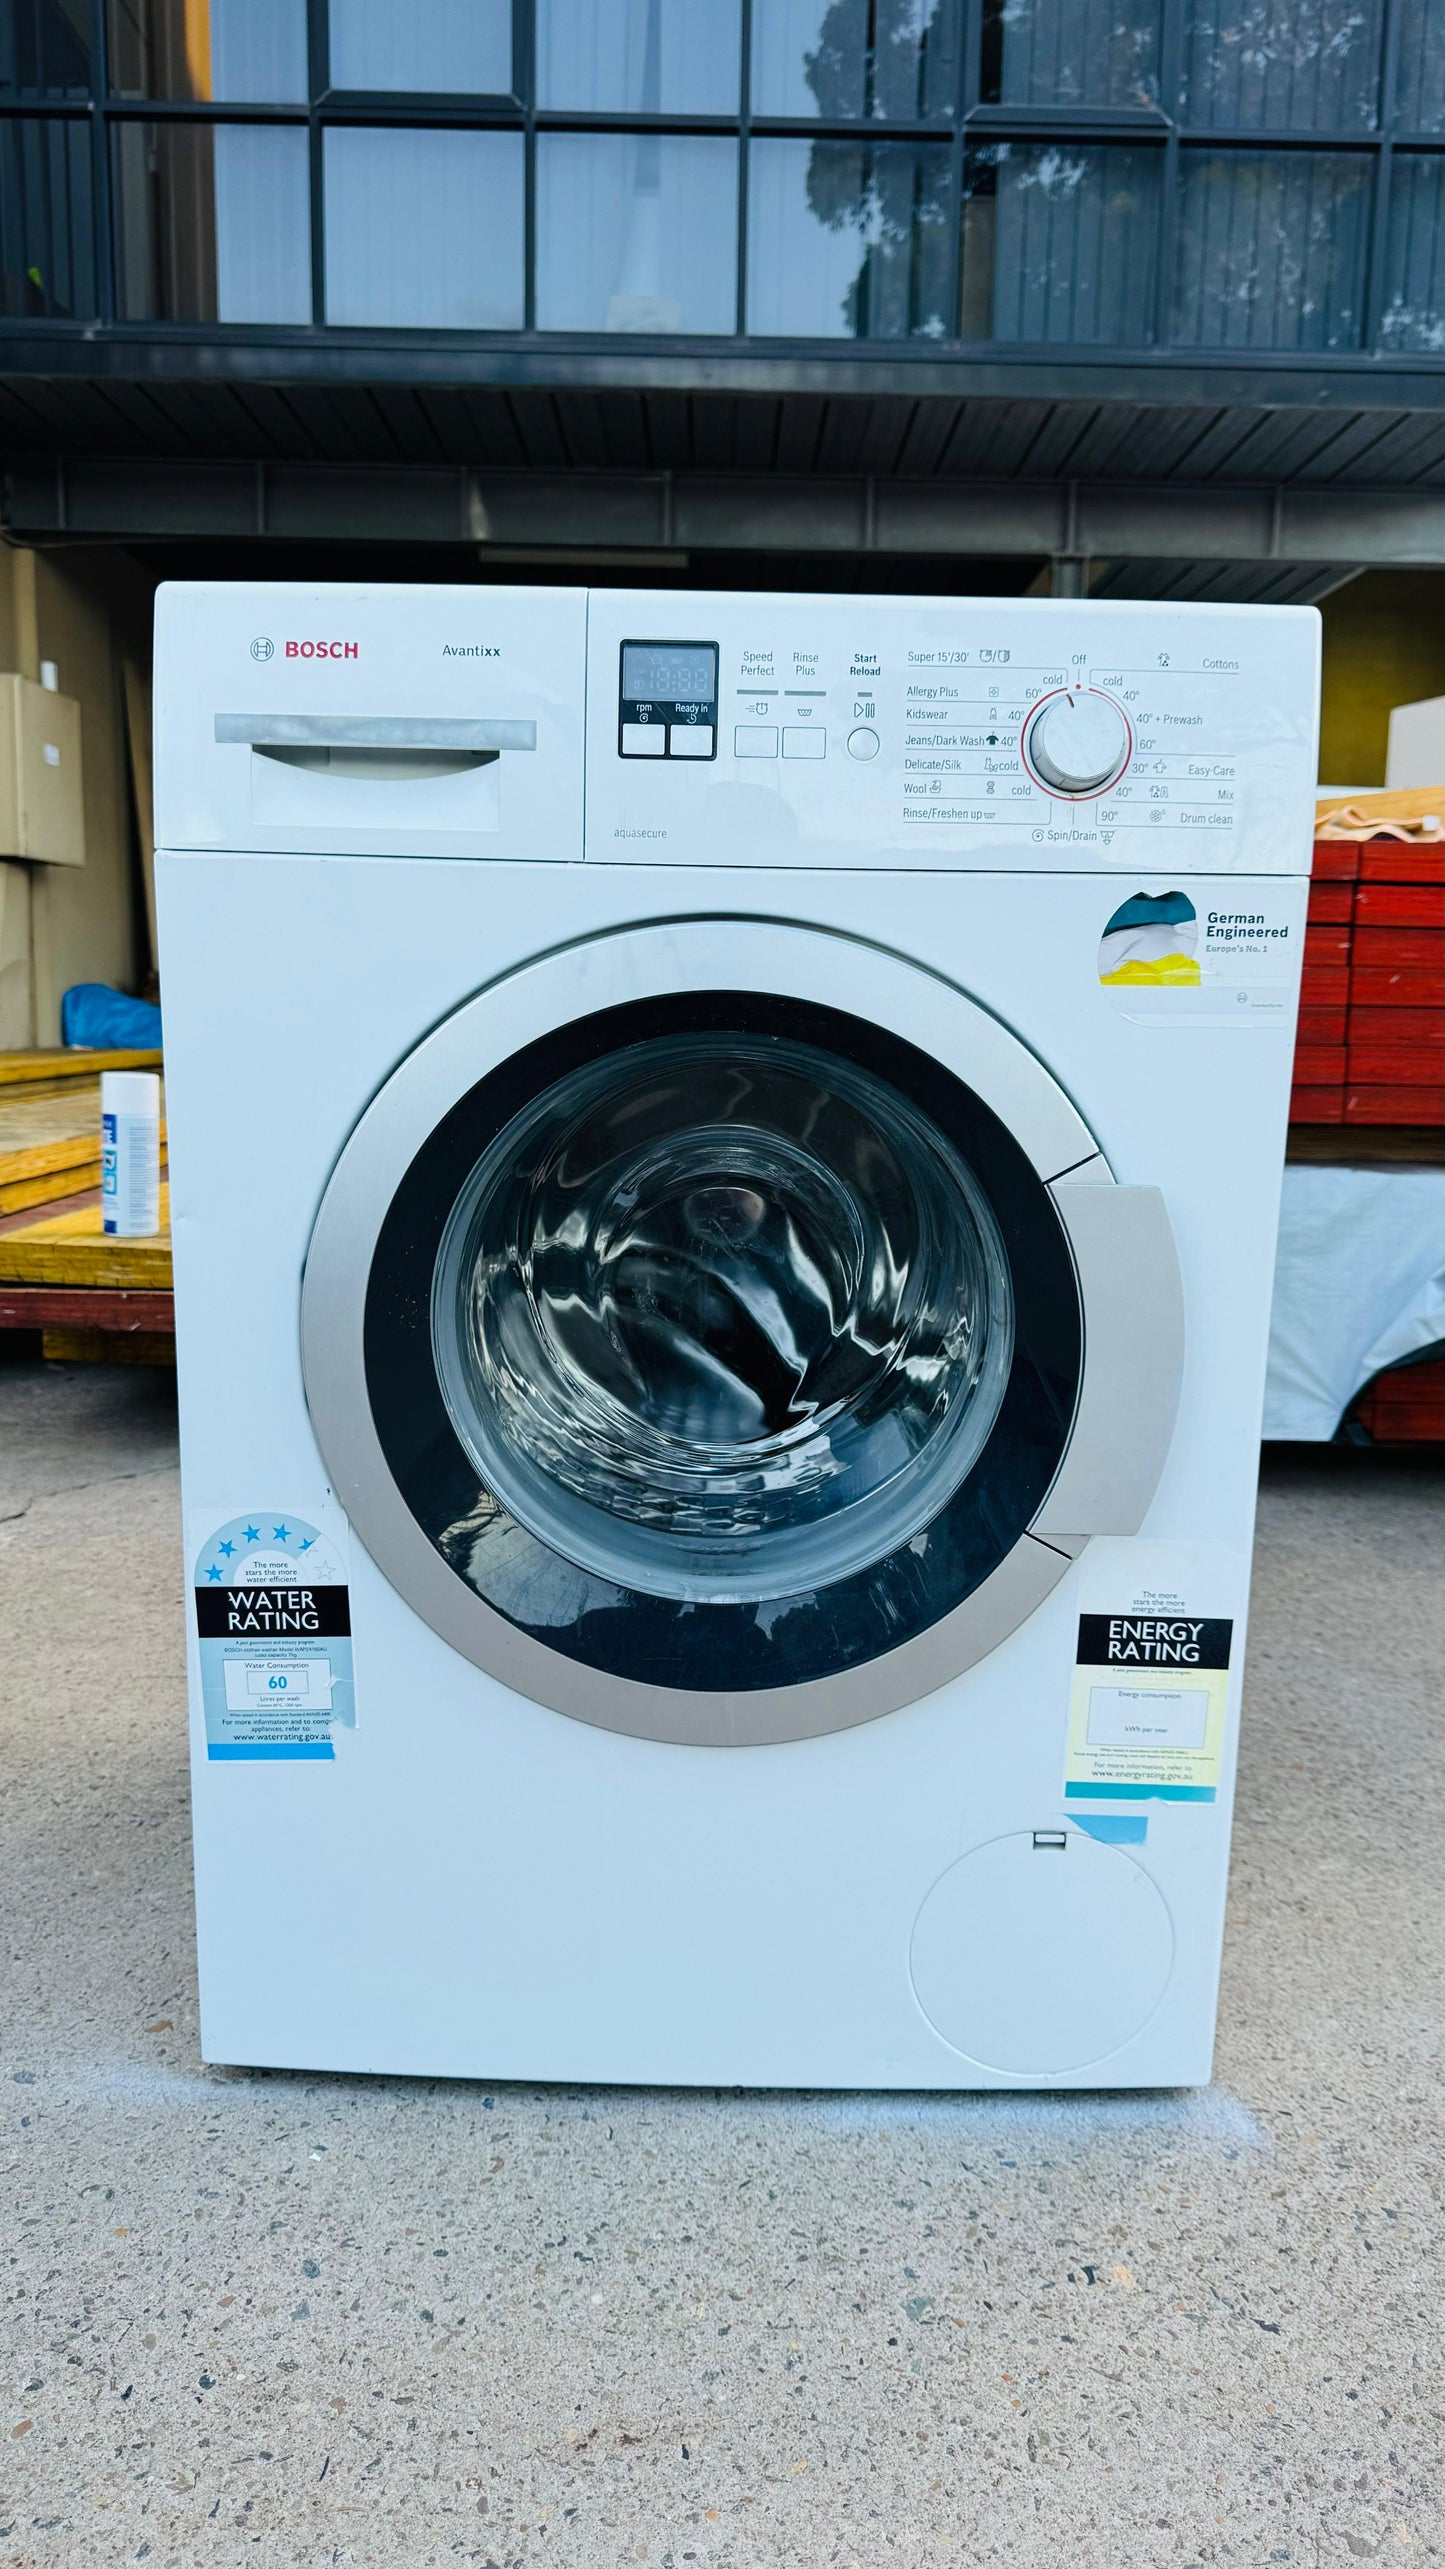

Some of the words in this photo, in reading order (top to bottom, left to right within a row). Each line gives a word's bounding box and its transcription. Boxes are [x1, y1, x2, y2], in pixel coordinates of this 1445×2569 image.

[285, 641, 358, 659] BOSCH
[443, 644, 501, 657] Avantixx
[743, 652, 773, 663] Speed
[793, 653, 818, 662] Rinse
[854, 653, 877, 663] Start
[908, 652, 936, 664] Super
[1072, 655, 1087, 665] Off
[1202, 658, 1239, 669] Cottons
[741, 666, 775, 676] Perfect
[796, 666, 815, 676] Plus
[850, 667, 880, 676] Reload
[1043, 674, 1062, 685] cold
[1103, 675, 1122, 686] cold
[907, 687, 937, 698] Allergy
[939, 687, 958, 697] Plus
[1026, 688, 1042, 698] 60°
[1123, 690, 1140, 700] 40°
[636, 704, 652, 713] rpm
[676, 704, 698, 713] Ready
[700, 704, 708, 712] in
[906, 709, 948, 720] Kidswear
[1008, 710, 1025, 720] 40°
[1137, 713, 1153, 723] 40°
[1163, 714, 1202, 725] Prewash
[905, 734, 957, 746] Jeans/Dark
[959, 735, 984, 746] Wash
[1001, 736, 1018, 746] 40°
[1140, 739, 1156, 749] 60°
[905, 759, 961, 770] Delicate/Silk
[999, 760, 1018, 771] cold
[1132, 762, 1149, 773] 30°
[1188, 765, 1235, 778] Easy-Care
[904, 783, 927, 794] Wool
[1011, 784, 1031, 796] cold
[1116, 787, 1132, 797] 40°
[1218, 789, 1234, 800] Mix
[903, 808, 968, 819] Rinse/Freshen
[970, 810, 982, 821] up
[1101, 811, 1118, 821] 90°
[1180, 813, 1204, 823] Drum
[1207, 813, 1233, 824] clean
[614, 829, 667, 839] aquasecure
[1048, 830, 1097, 842] Spin/Drain
[1208, 912, 1264, 924] German
[1206, 926, 1288, 939] Engineered
[1206, 945, 1244, 953] Europe's
[228, 1591, 316, 1610] WATER
[1132, 1606, 1155, 1614] energy
[1158, 1606, 1185, 1614] efficient
[228, 1612, 319, 1630] RATING
[1109, 1621, 1203, 1641] ENERGY
[1108, 1642, 1200, 1662] RATING
[268, 1676, 287, 1689] 60
[1118, 1690, 1139, 1699] Energy
[1141, 1692, 1181, 1700] consumption
[1092, 1770, 1193, 1780] www.energyrating.gov.au
